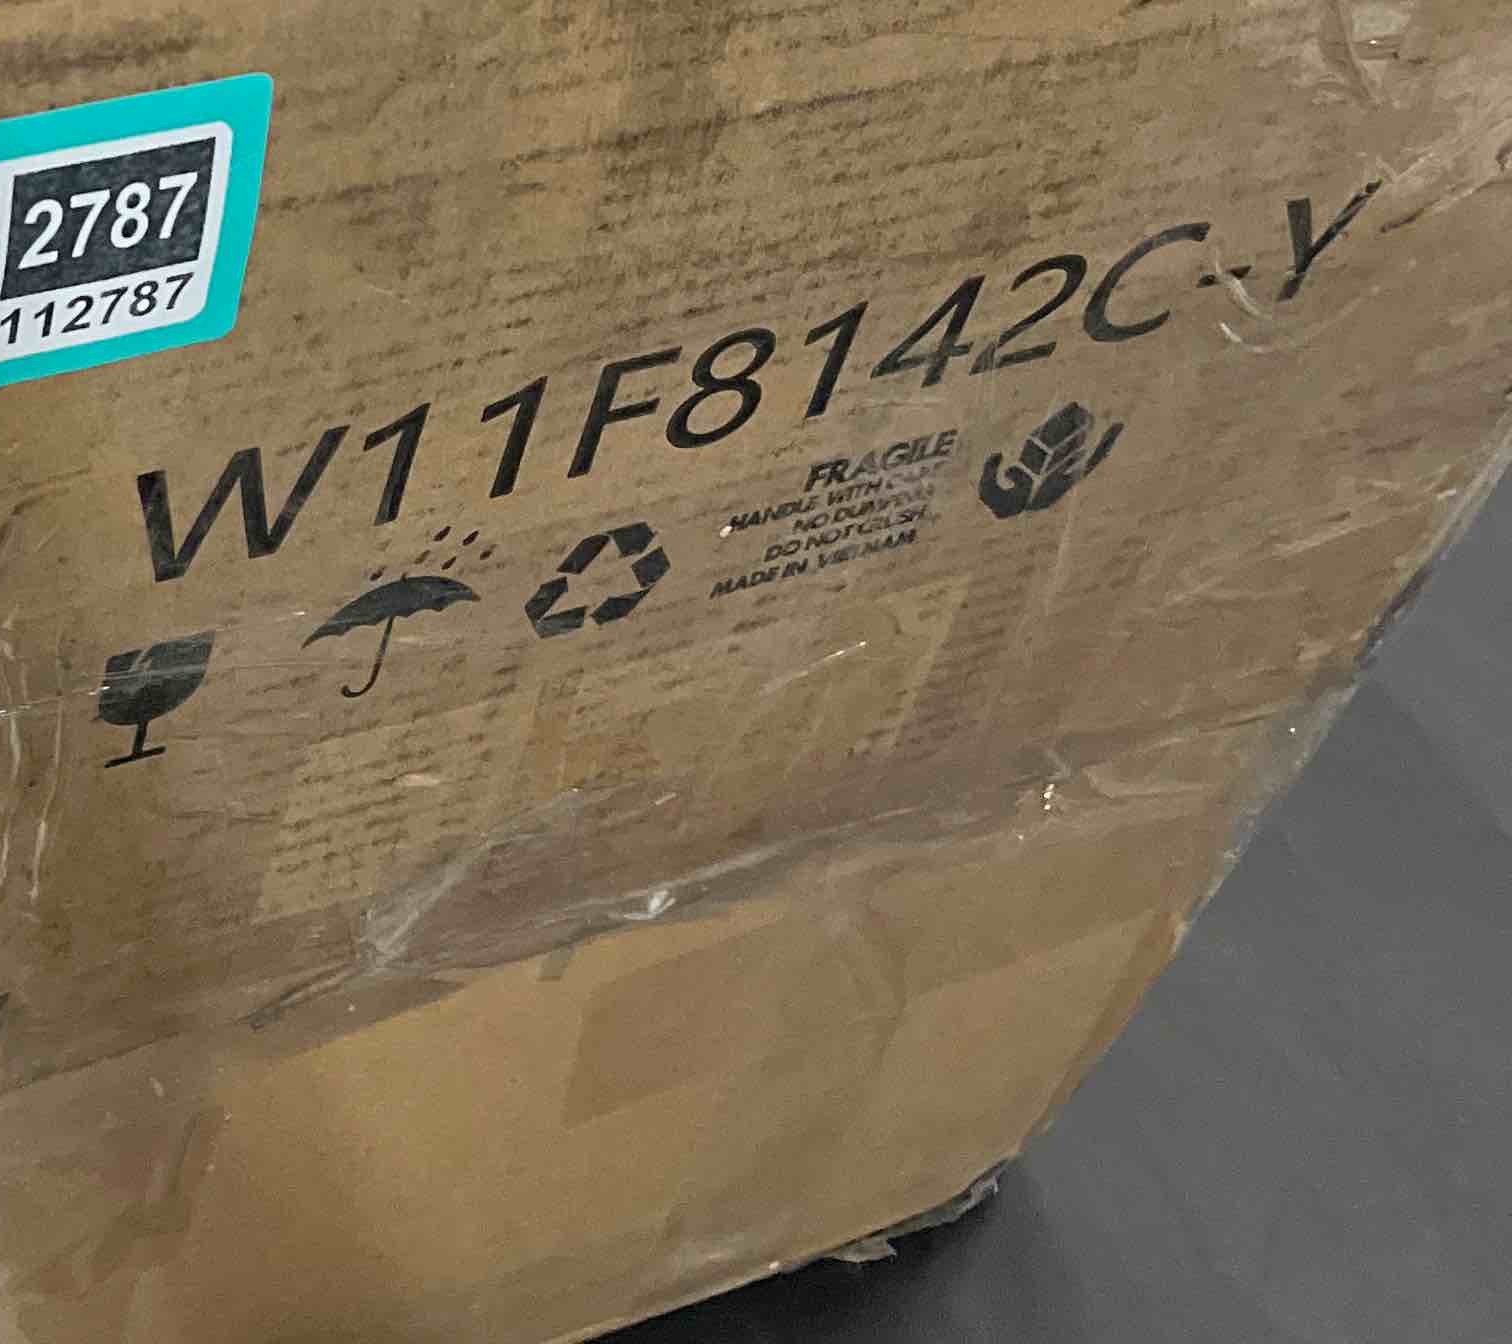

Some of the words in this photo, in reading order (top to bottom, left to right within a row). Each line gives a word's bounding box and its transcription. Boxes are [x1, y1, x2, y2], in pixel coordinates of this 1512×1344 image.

[16, 172, 199, 271] 2787
[136, 178, 1384, 583] W11F8142C-Y
[804, 428, 958, 493] FRAGILE
[728, 494, 819, 532] HANDLE
[826, 478, 884, 507] WITH
[763, 540, 802, 563] DO
[804, 525, 854, 552] NOT
[709, 566, 781, 600] MADE
[781, 557, 809, 580] IN
